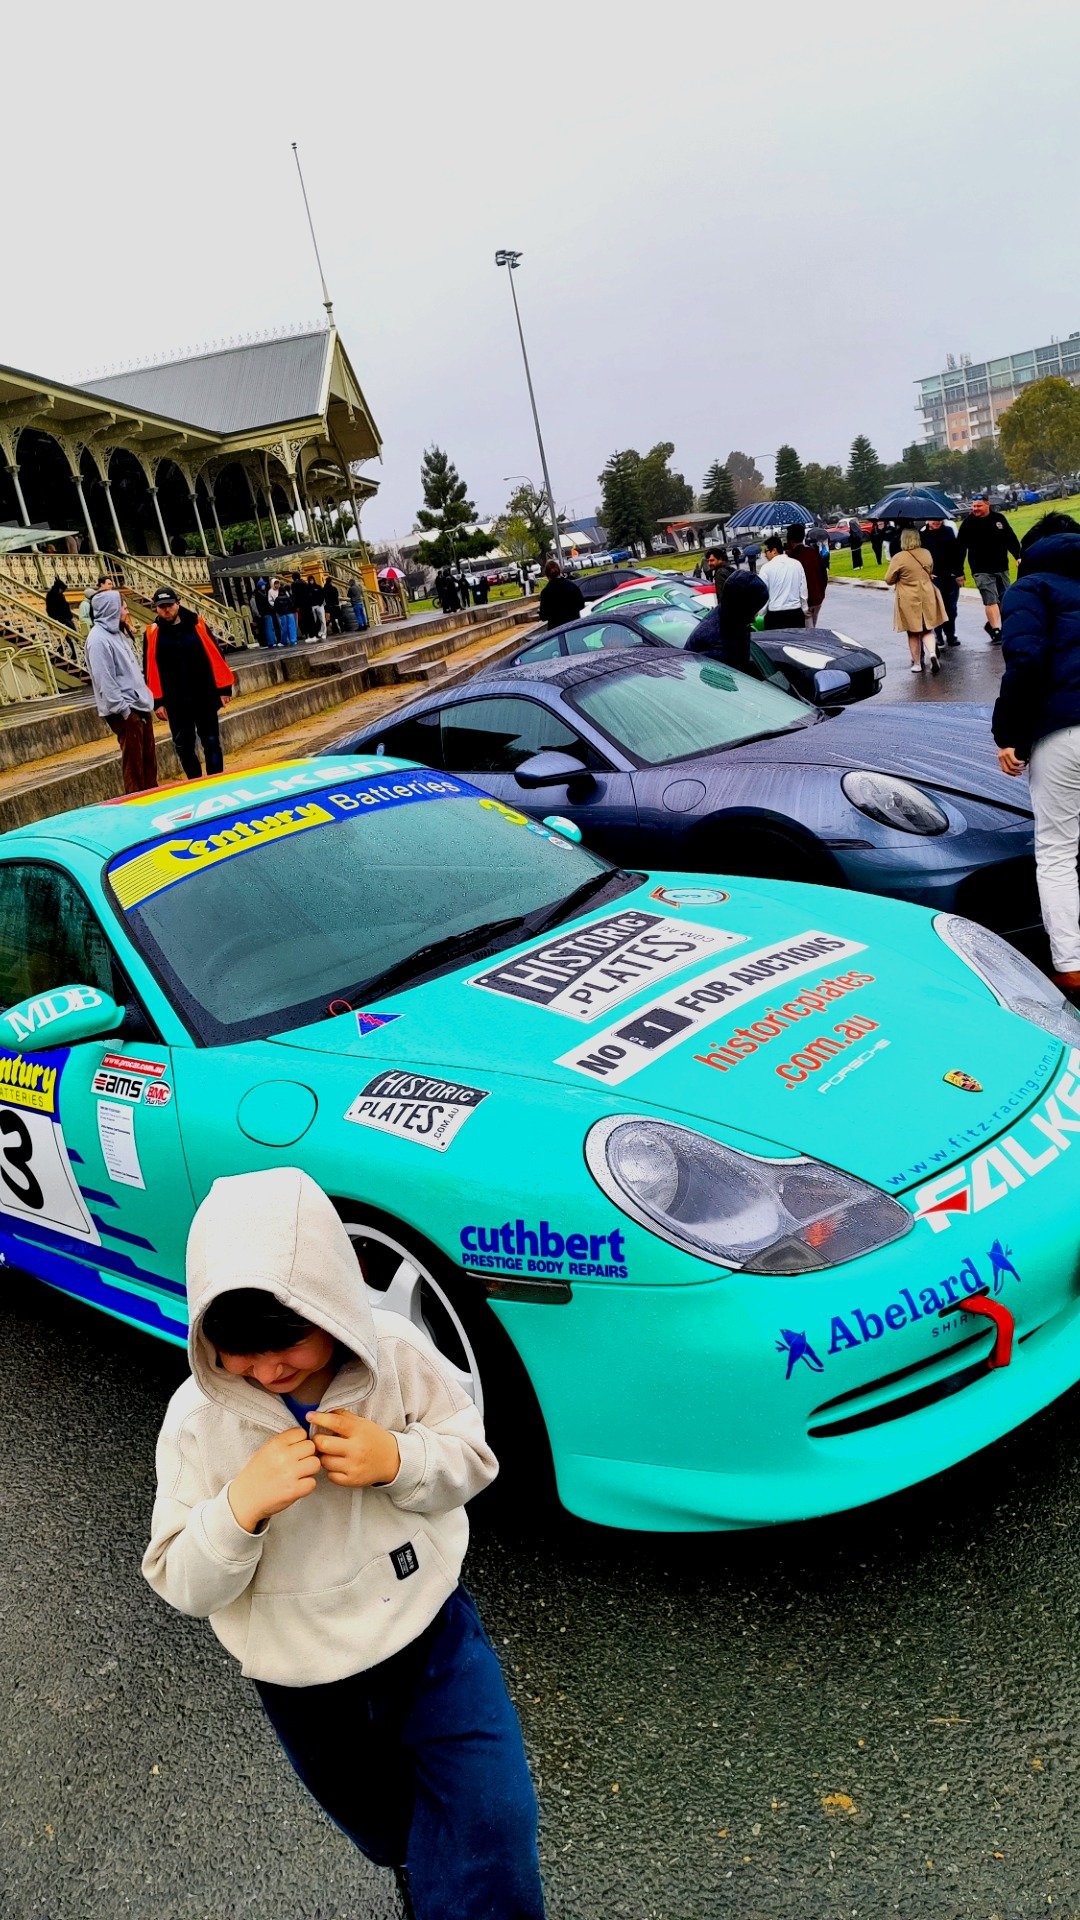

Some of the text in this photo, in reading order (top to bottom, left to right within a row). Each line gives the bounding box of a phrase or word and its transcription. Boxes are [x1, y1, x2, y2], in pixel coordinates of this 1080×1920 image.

[169, 779, 461, 860] Century Batteries
[479, 798, 528, 825] 3
[497, 917, 648, 993] HISTORIC
[569, 934, 697, 1004] PLATES
[4, 986, 103, 1042] MDB
[576, 936, 846, 1076] NO 1 FOR AUCTIONS
[693, 970, 876, 1073] historicplates
[774, 1013, 881, 1090] .com.au
[817, 1038, 892, 1094] PORSCHE
[147, 1086, 170, 1101] BMC
[358, 1101, 444, 1134] PLATES
[371, 1072, 475, 1102] HISTORIC
[886, 1039, 1060, 1186] www.fitz-racing.com.au
[912, 1047, 1080, 1234] FALKE
[459, 1219, 626, 1263] cuthbert
[462, 1253, 628, 1279] PRESTIGE BODY REPAIRS
[827, 1257, 986, 1355] Abelard
